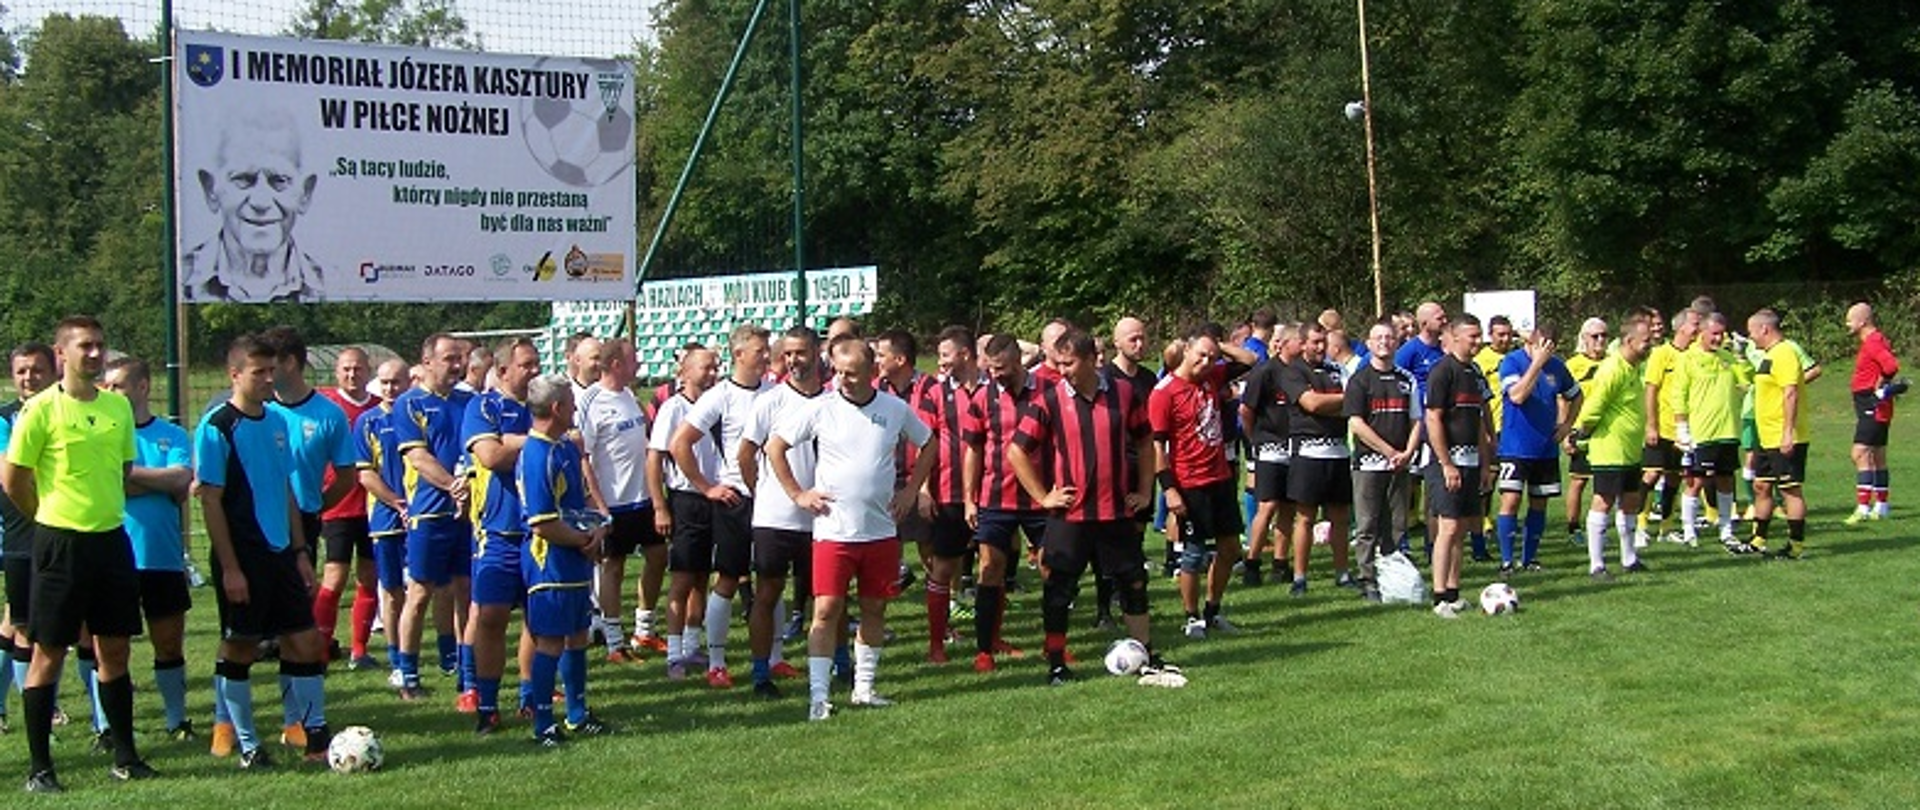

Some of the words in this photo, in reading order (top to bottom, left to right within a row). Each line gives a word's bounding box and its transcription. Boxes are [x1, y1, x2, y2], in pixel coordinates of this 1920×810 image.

[232, 50, 240, 79] I
[248, 51, 383, 88] MEMORIAŁ
[388, 56, 469, 93] JÓZEFA
[473, 66, 590, 100] KASZTURY
[320, 98, 347, 128] W
[353, 100, 420, 131] PIŁCE
[427, 101, 509, 136] NOŻNEJ
[360, 159, 396, 178] tacy
[399, 159, 450, 180] ludzie,
[392, 184, 441, 206] którzy
[444, 186, 487, 207] nigdy
[490, 188, 514, 206] nie
[517, 190, 589, 210] przestaną
[480, 213, 508, 233] być
[510, 213, 534, 232] dla
[537, 216, 563, 232] nas
[812, 275, 850, 300] 1950
